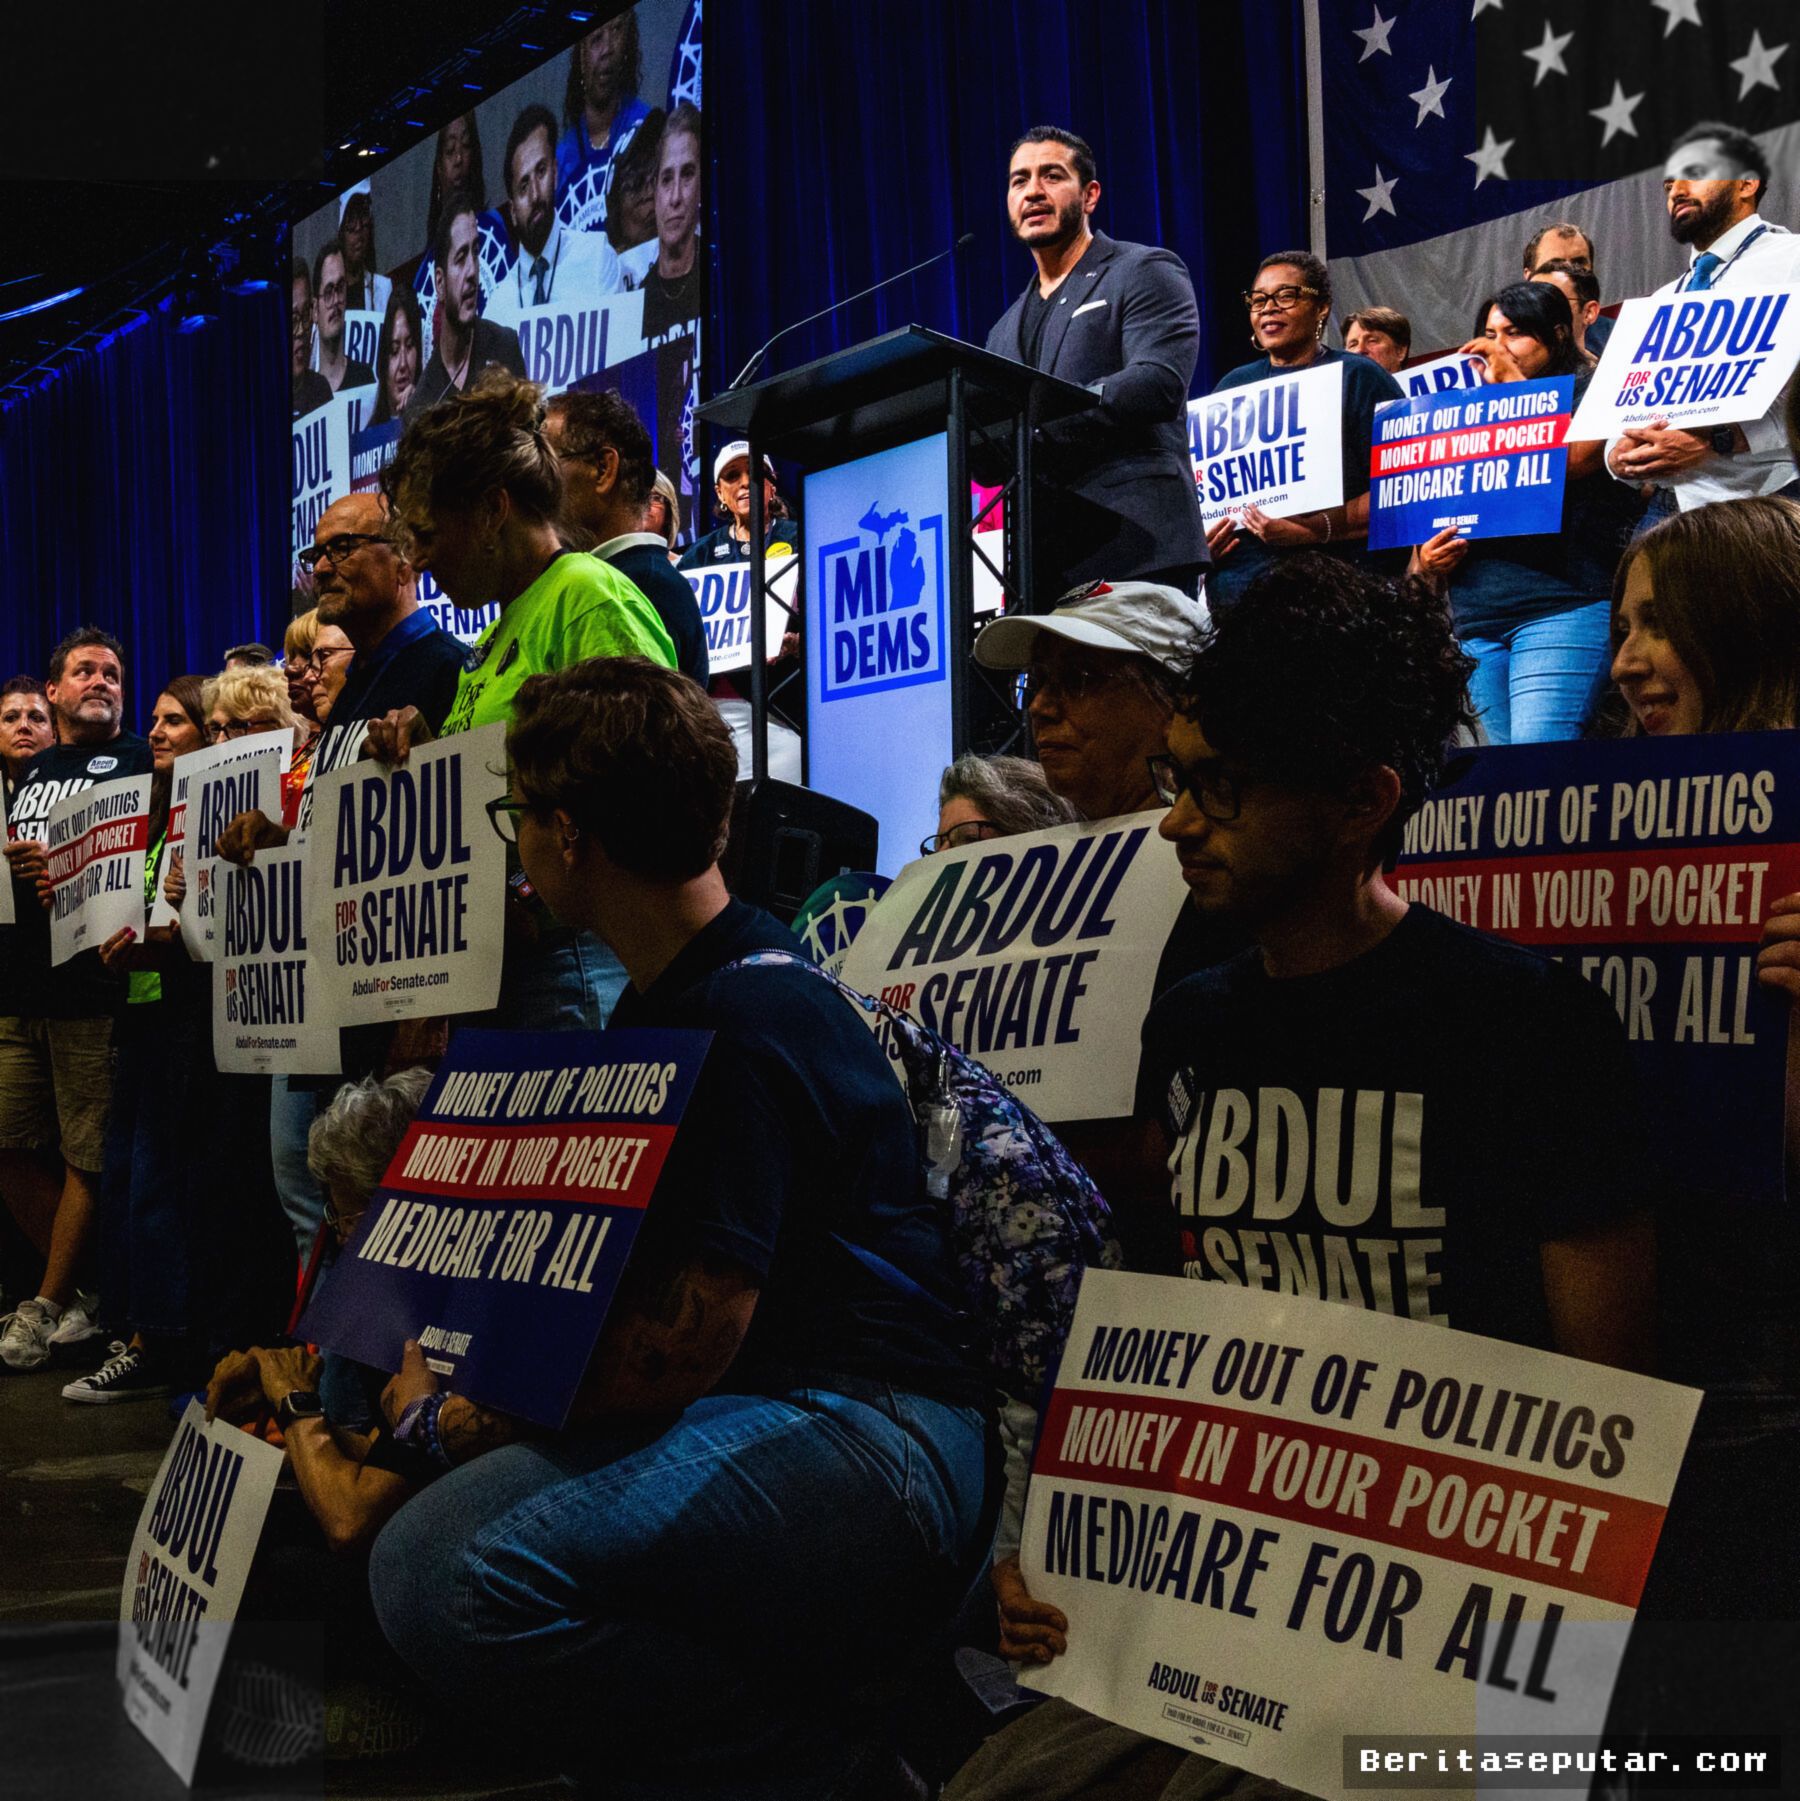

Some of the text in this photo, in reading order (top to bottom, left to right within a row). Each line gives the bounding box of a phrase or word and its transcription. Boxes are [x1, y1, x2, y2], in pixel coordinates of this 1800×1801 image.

[1631, 293, 1791, 365] ABDUL
[1615, 357, 1767, 407] US SENATE
[1623, 371, 1651, 389] FOR
[1186, 381, 1307, 463] ABDUL
[1381, 390, 1560, 441] MONEY OUT OF POLITICS
[1621, 406, 1720, 423] AbdulForSenate.com
[352, 445, 383, 481] MONEY
[1207, 441, 1306, 503] SENATE
[1380, 421, 1557, 471] MONEY IN YOUR POCKET
[1378, 453, 1552, 510] MEDICARE FOR ALL
[834, 545, 888, 624] MI
[834, 612, 931, 684] DEMS
[72, 809, 86, 835] OUT
[93, 789, 140, 823] POLITICS
[95, 822, 138, 854] POCKET
[334, 752, 471, 889] ABDUL
[1400, 769, 1776, 856] MONEY OUT OF POLITICS
[104, 857, 132, 892] ALL
[197, 869, 209, 894] FOR
[197, 888, 209, 918] US
[886, 826, 1152, 972] ABDUL
[1492, 872, 1521, 930] IN
[1532, 868, 1615, 929] YOUR
[1626, 862, 1770, 928] POCKET
[224, 859, 307, 957] ABDUL
[335, 899, 358, 934] FOR
[336, 873, 470, 967] US SENATE
[226, 968, 237, 994] FOR
[226, 990, 238, 1022] US
[352, 970, 450, 997] AbdulForSenate.com
[918, 948, 1101, 1054] SENATE
[1674, 955, 1756, 1045] ALL
[235, 1036, 297, 1050] AbdulForSenate.com
[431, 1061, 677, 1119] MONEY OUT OF POLITICS
[401, 1133, 650, 1191] MONEY IN YOUR POCKET
[1167, 1087, 1447, 1229] ABDUL
[357, 1198, 612, 1294] MEDICARE FOR ALL
[1202, 1226, 1450, 1329] SENATE
[416, 1325, 447, 1351] ABDUL
[1082, 1325, 1636, 1480] MONEY OUT OF POLITICS
[147, 1420, 245, 1588] ABDUL
[1058, 1405, 1611, 1575] MONEY IN YOUR POCKET
[137, 1550, 150, 1585] FOR
[137, 1555, 209, 1692] SENATE
[1044, 1490, 1565, 1705] MEDICARE FOR ALL
[1147, 1661, 1201, 1704] ABDUL
[1201, 1684, 1289, 1732] US SENATE
[1203, 1680, 1219, 1693] FOR
[1226, 1725, 1247, 1742] SENATE
